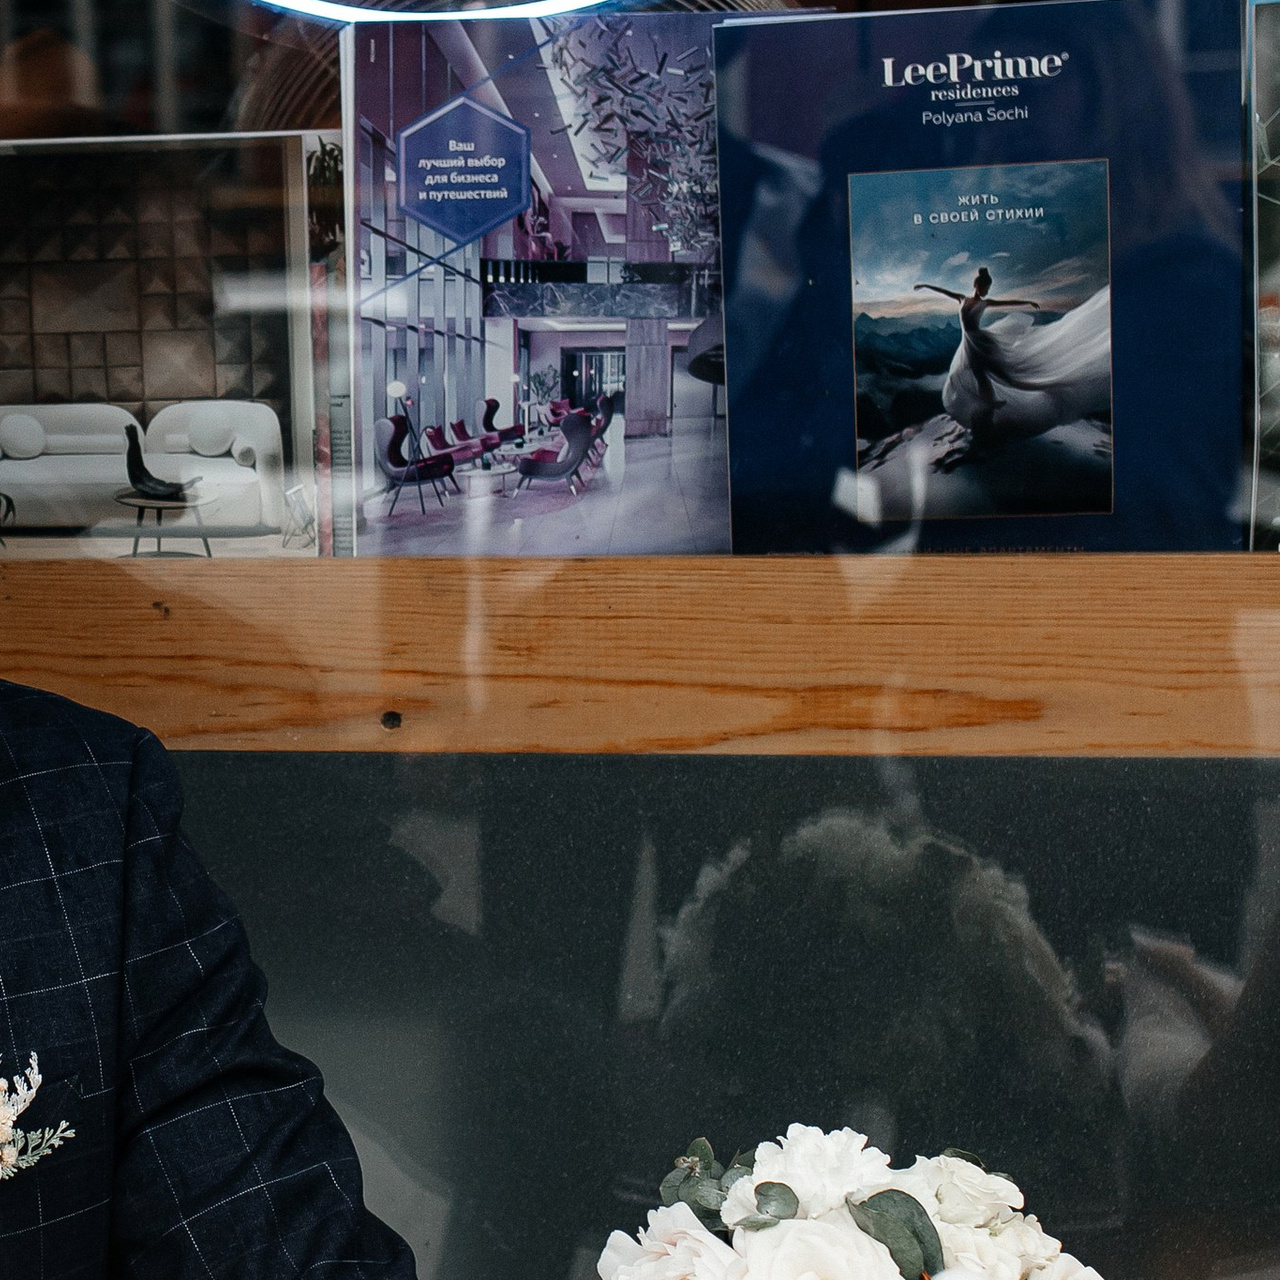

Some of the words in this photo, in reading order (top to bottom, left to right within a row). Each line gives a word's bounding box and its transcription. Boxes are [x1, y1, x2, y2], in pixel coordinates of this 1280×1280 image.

[930, 83, 1020, 101] residences
[922, 110, 983, 127] Polyana
[986, 106, 1029, 121] Sochi
[448, 140, 475, 151] Ваш
[418, 156, 465, 170] лучший
[467, 155, 506, 168] выбор
[424, 174, 448, 185] для
[450, 172, 499, 184] бизнеса
[418, 191, 427, 200] и
[429, 187, 508, 201] путешествий
[958, 193, 999, 206] ЖИТЬ
[913, 213, 922, 224] В
[929, 208, 979, 224] СВОЕЙ
[985, 206, 1044, 221] СТИХИИ
